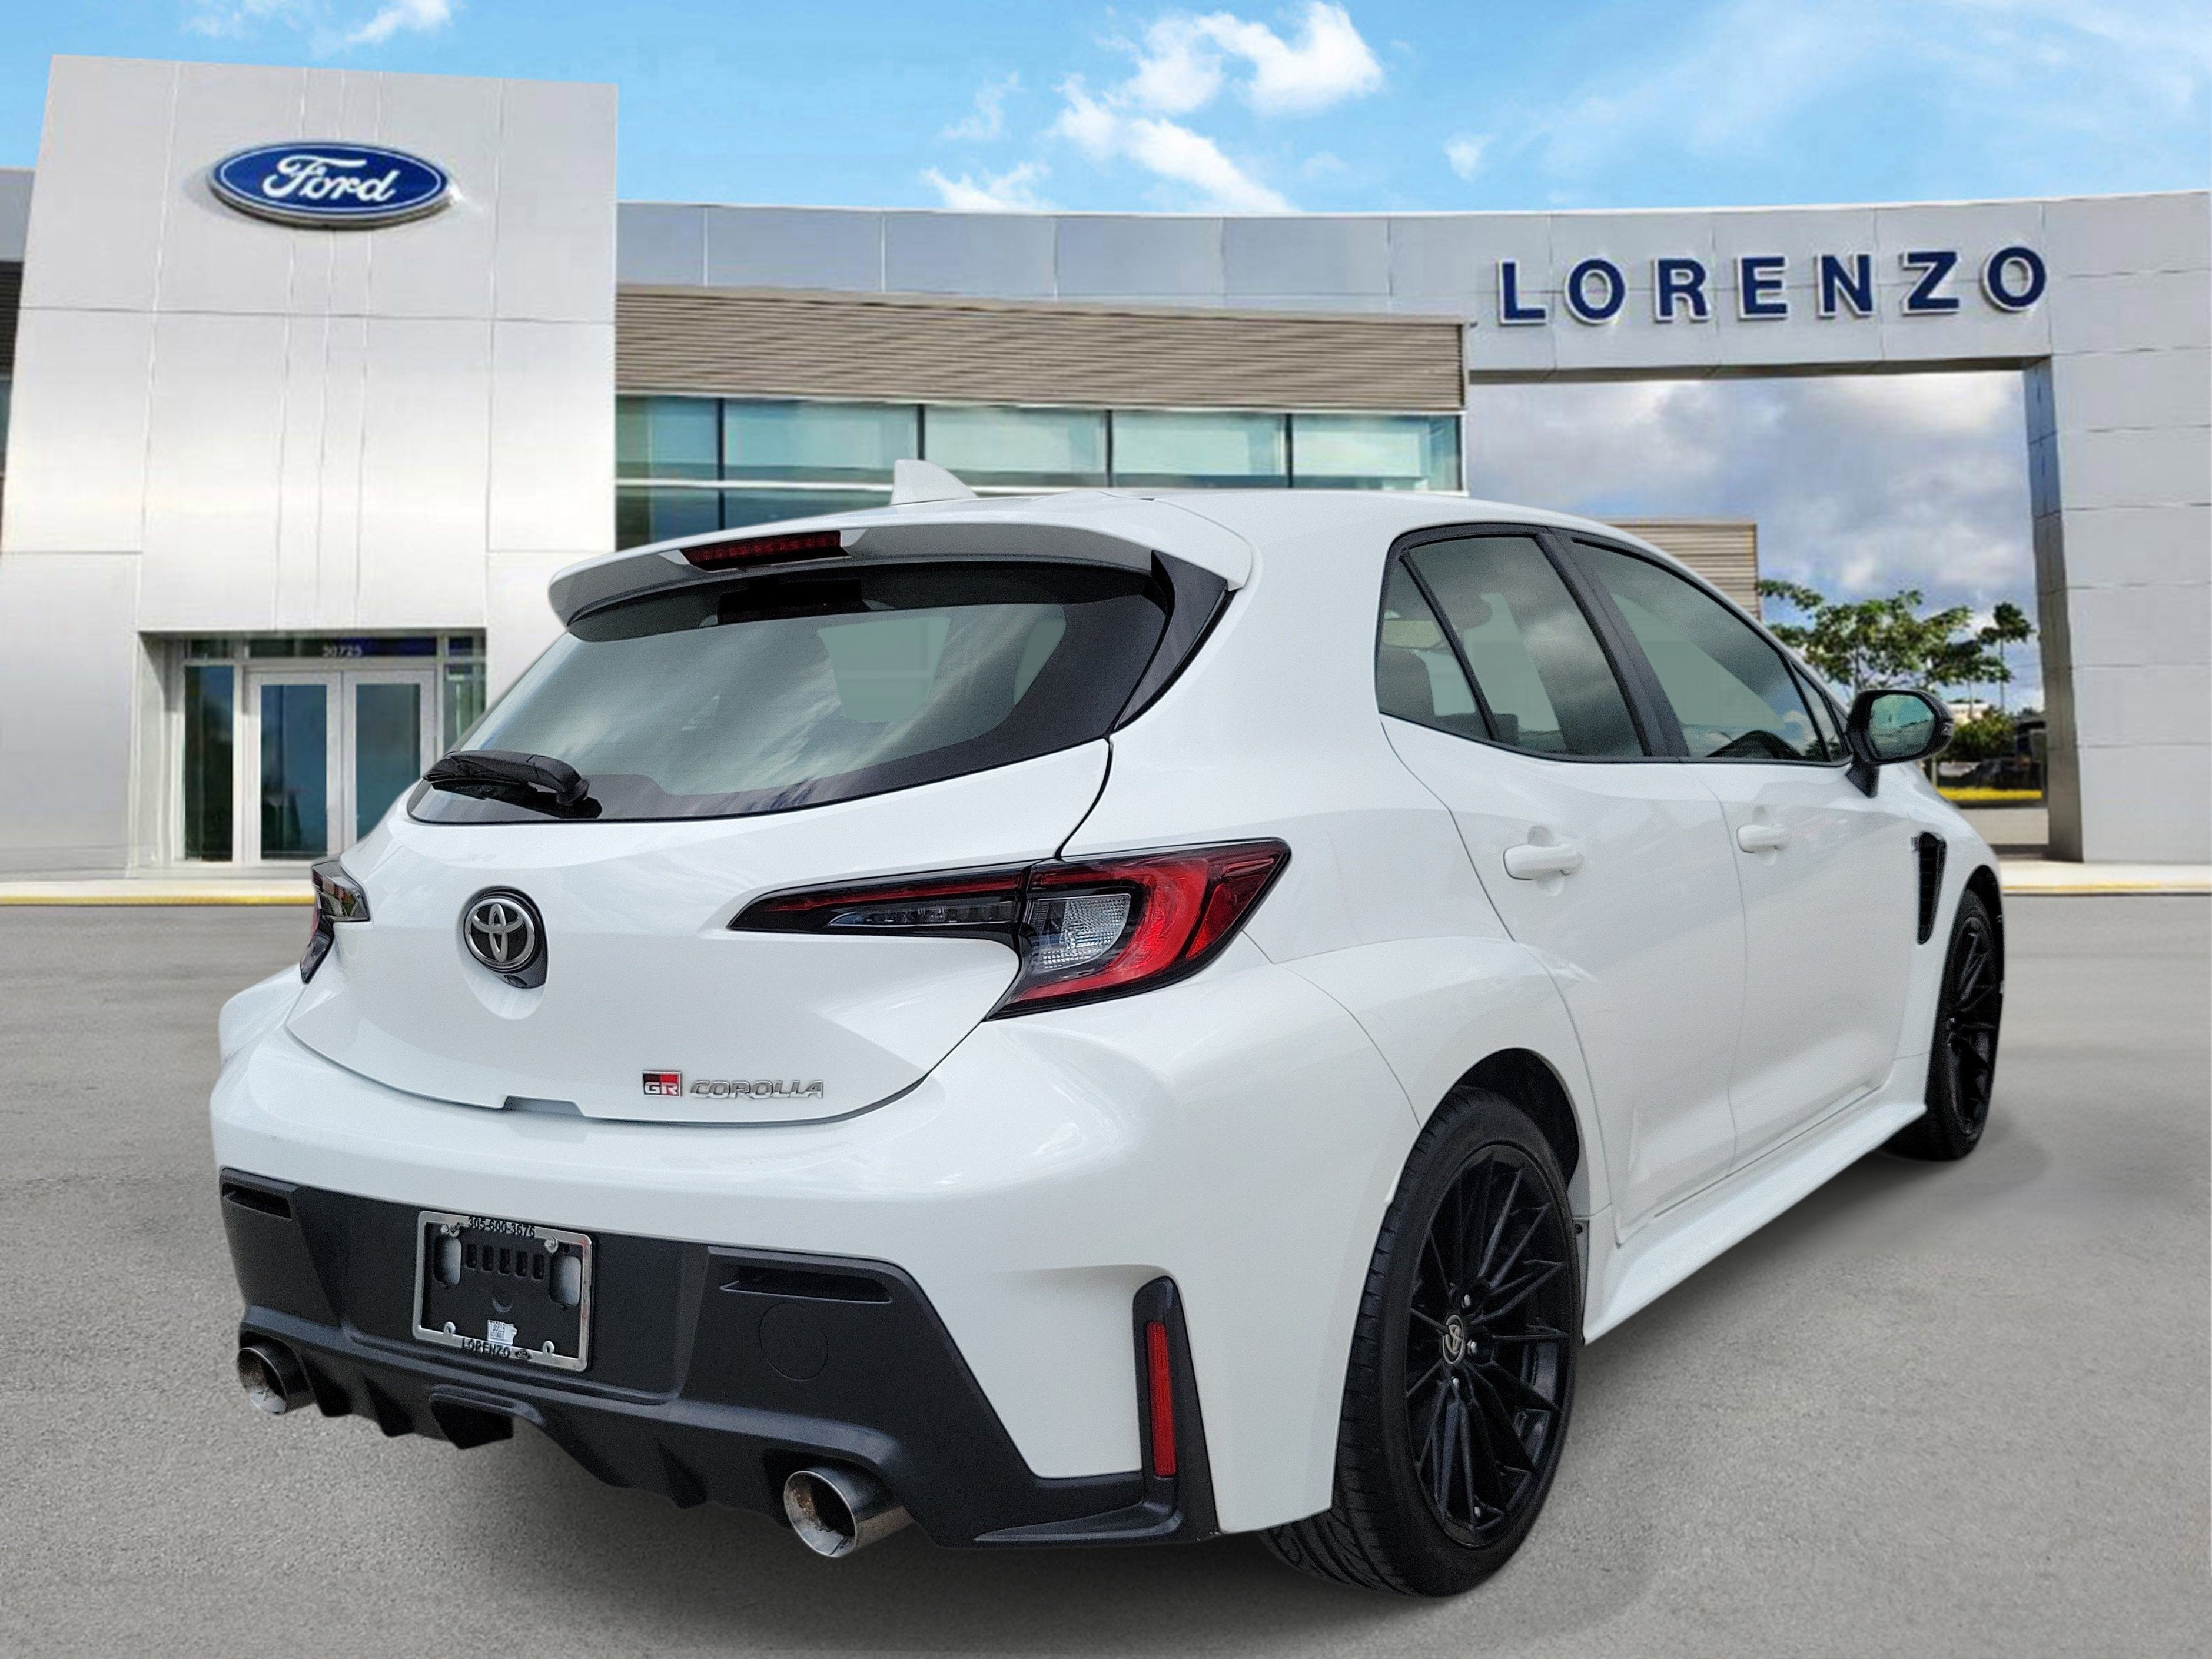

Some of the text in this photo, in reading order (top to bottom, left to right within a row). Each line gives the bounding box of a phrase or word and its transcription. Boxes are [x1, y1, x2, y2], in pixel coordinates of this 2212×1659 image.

[261, 154, 401, 203] Ford
[1497, 245, 2047, 325] LORENZO
[645, 1079, 824, 1099] GR COROLLA
[468, 1216, 536, 1238] 305-600-3676
[461, 1338, 510, 1357] LORENZO
